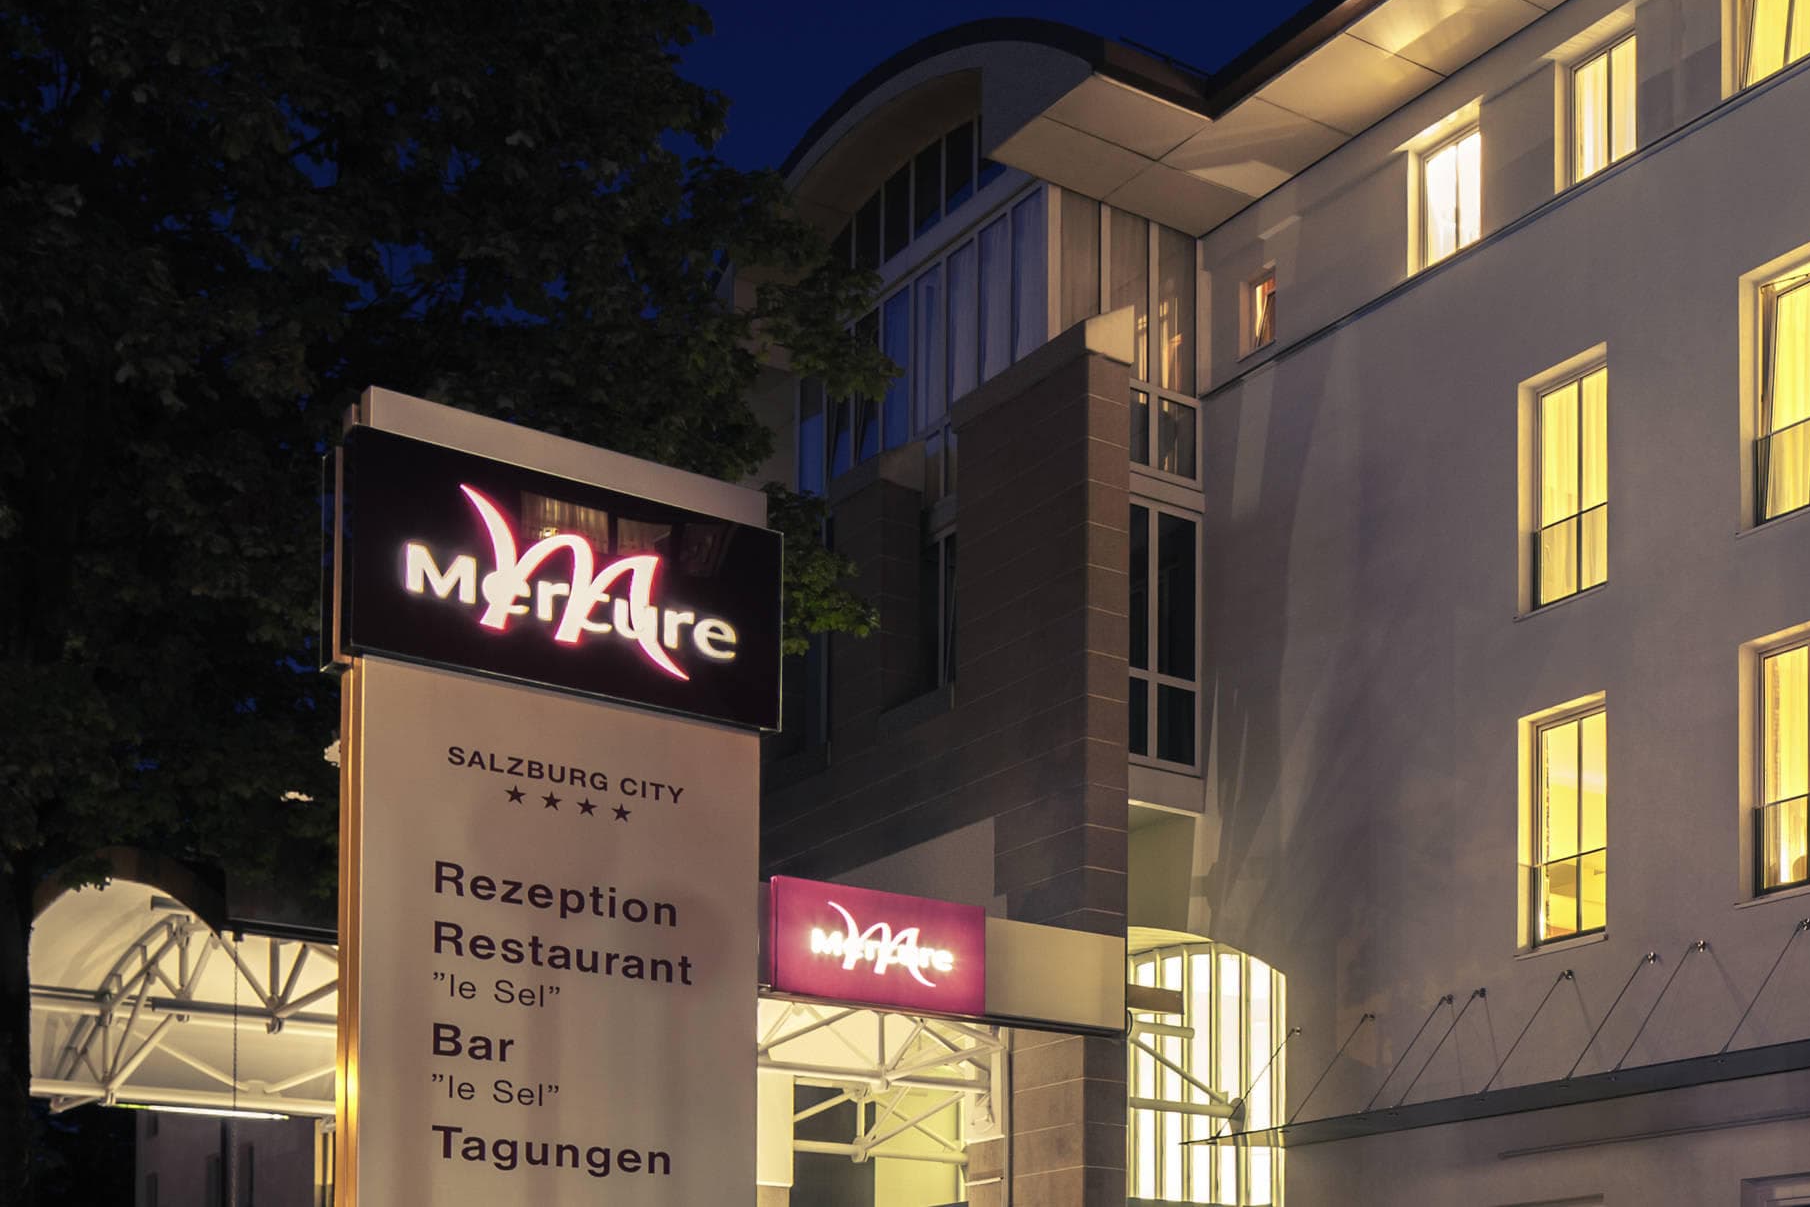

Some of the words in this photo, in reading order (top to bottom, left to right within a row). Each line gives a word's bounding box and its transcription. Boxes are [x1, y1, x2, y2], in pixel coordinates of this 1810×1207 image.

[404, 540, 738, 660] Mercure
[447, 747, 609, 792] SALZBURG
[619, 777, 684, 804] CITY
[434, 861, 677, 927] Rezeption
[434, 921, 692, 985] Restaurant
[432, 1023, 514, 1062] Bar
[432, 1125, 671, 1178] Tagungen
